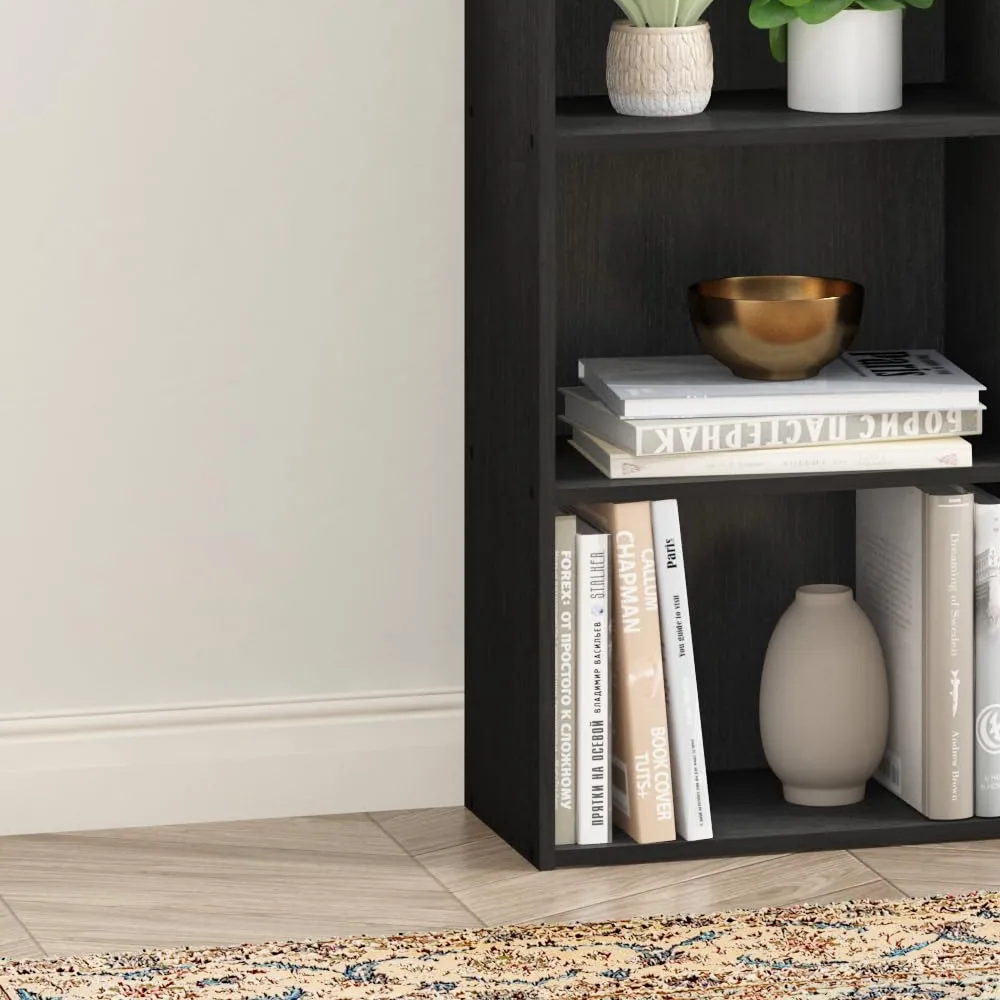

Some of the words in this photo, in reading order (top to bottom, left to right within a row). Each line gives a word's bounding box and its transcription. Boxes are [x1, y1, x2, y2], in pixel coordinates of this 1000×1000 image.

[651, 415, 847, 454] ПАСТЕРНАК
[858, 409, 963, 440] БОРИС
[663, 538, 678, 569] Paris
[948, 532, 960, 591] Dreaming
[560, 550, 572, 606] FOREX:
[615, 530, 640, 634] CHAPMAN
[640, 548, 659, 611] CALLUM
[560, 611, 572, 630] ОТ
[672, 595, 681, 610] visit
[673, 611, 682, 619] to
[950, 594, 960, 608] of
[593, 622, 602, 665] ВАСИЛЬЕВ
[675, 621, 686, 642] guide
[678, 643, 688, 658] You
[950, 609, 960, 656] Sweden
[560, 634, 572, 706] ПРОСТОГО
[593, 668, 602, 714] ВЛАДИМИР
[560, 710, 572, 720] К
[590, 719, 605, 761] ОСЕВОЙ
[650, 726, 669, 770] BOOK
[951, 730, 960, 767] Andrew
[560, 723, 572, 810] СЛОЖНОМУ
[590, 766, 604, 780] НА
[634, 752, 652, 800] TUTS+
[951, 770, 960, 801] Brown
[590, 784, 605, 826] ПРЯТКИ
[655, 772, 672, 821] COVER
